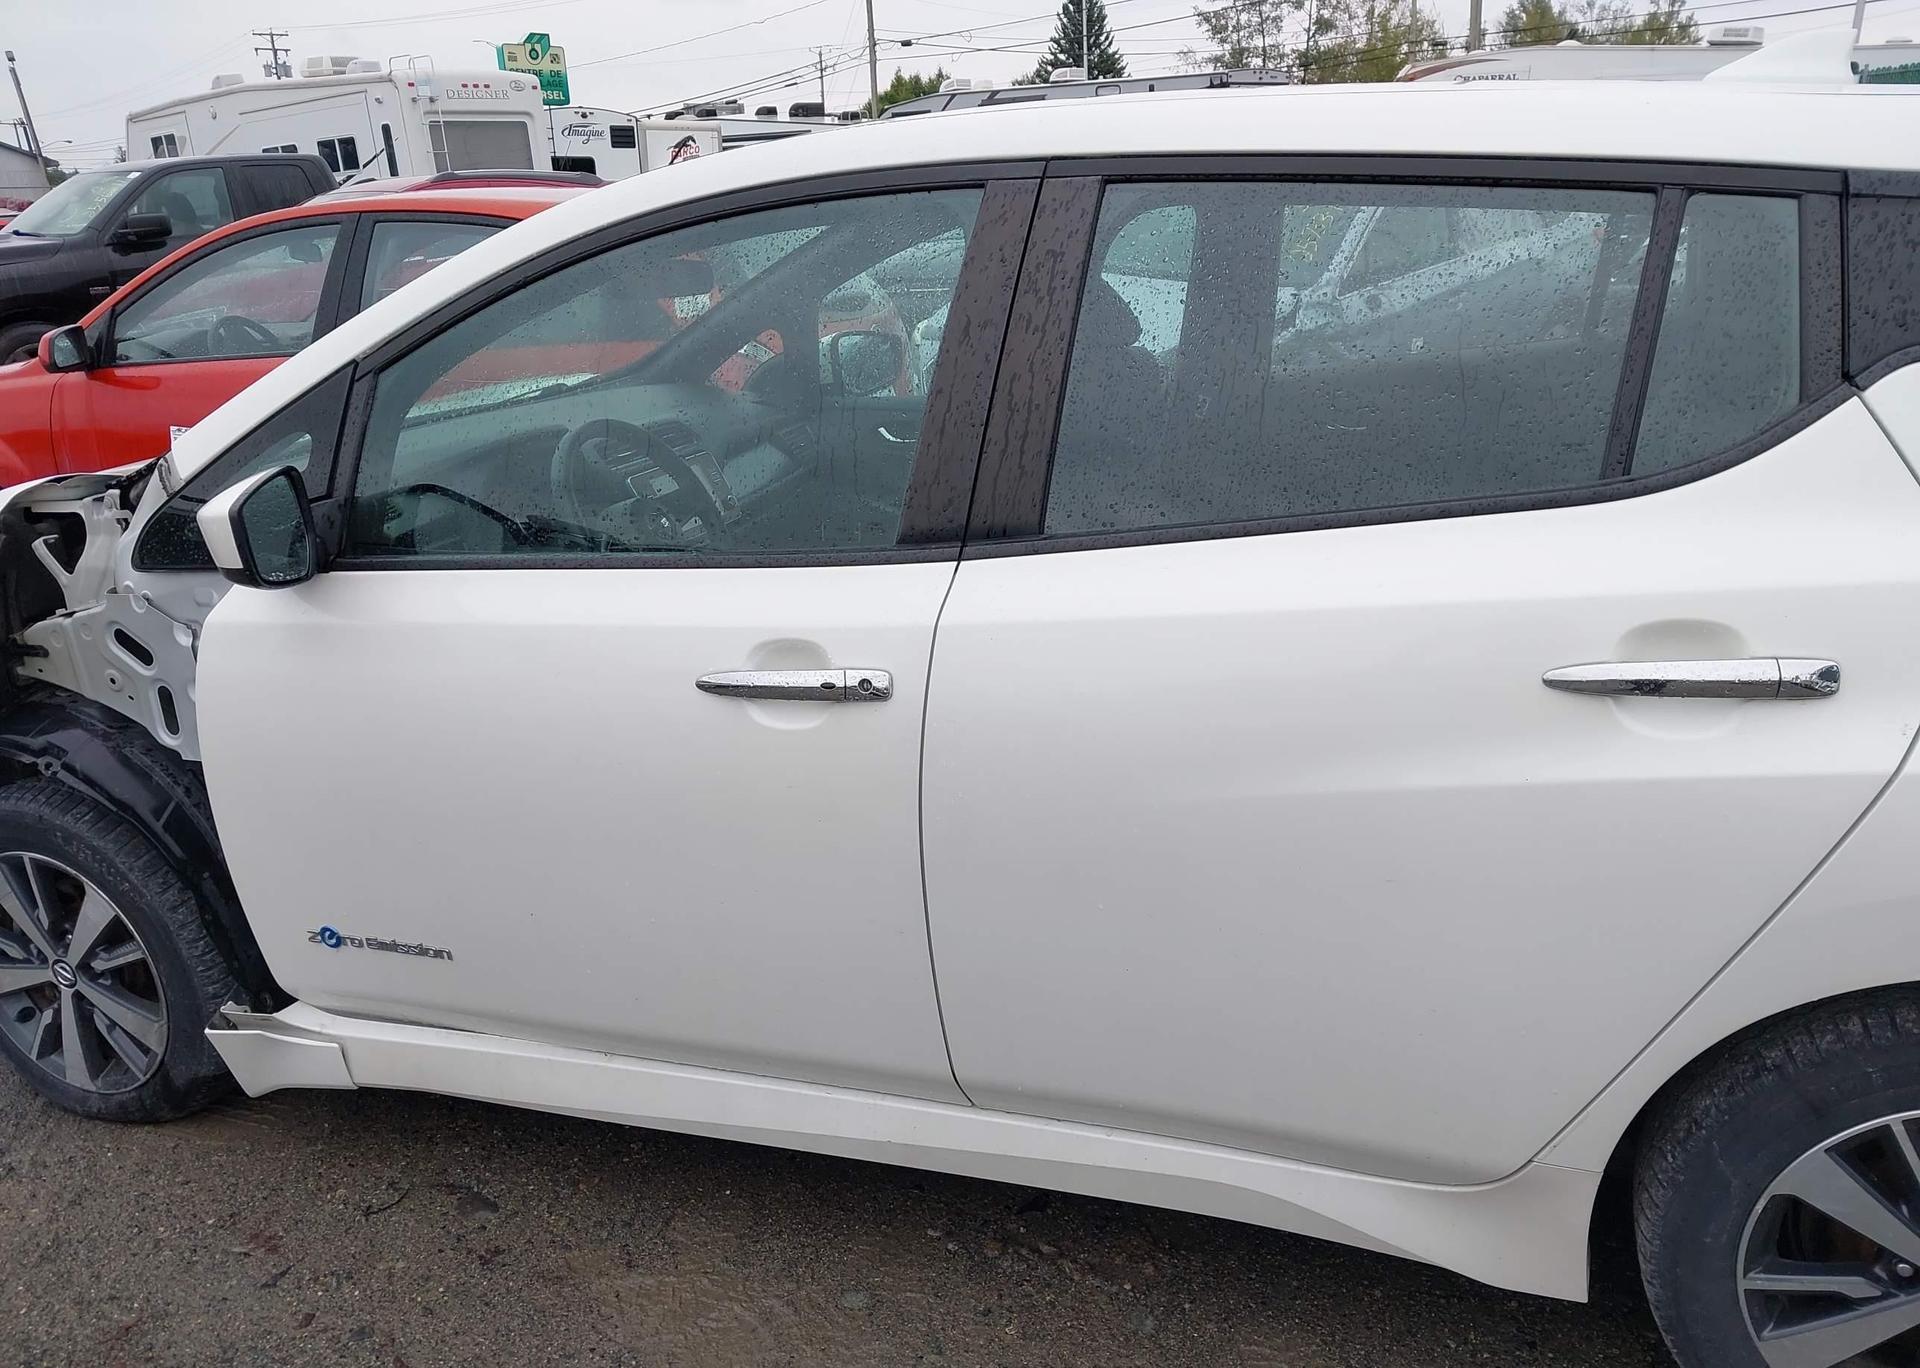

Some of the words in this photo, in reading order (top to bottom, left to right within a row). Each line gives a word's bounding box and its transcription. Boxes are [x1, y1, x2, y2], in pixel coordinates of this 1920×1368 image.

[549, 69, 562, 78] DE
[446, 89, 509, 99] DESIGNER
[561, 122, 607, 144] Imagine
